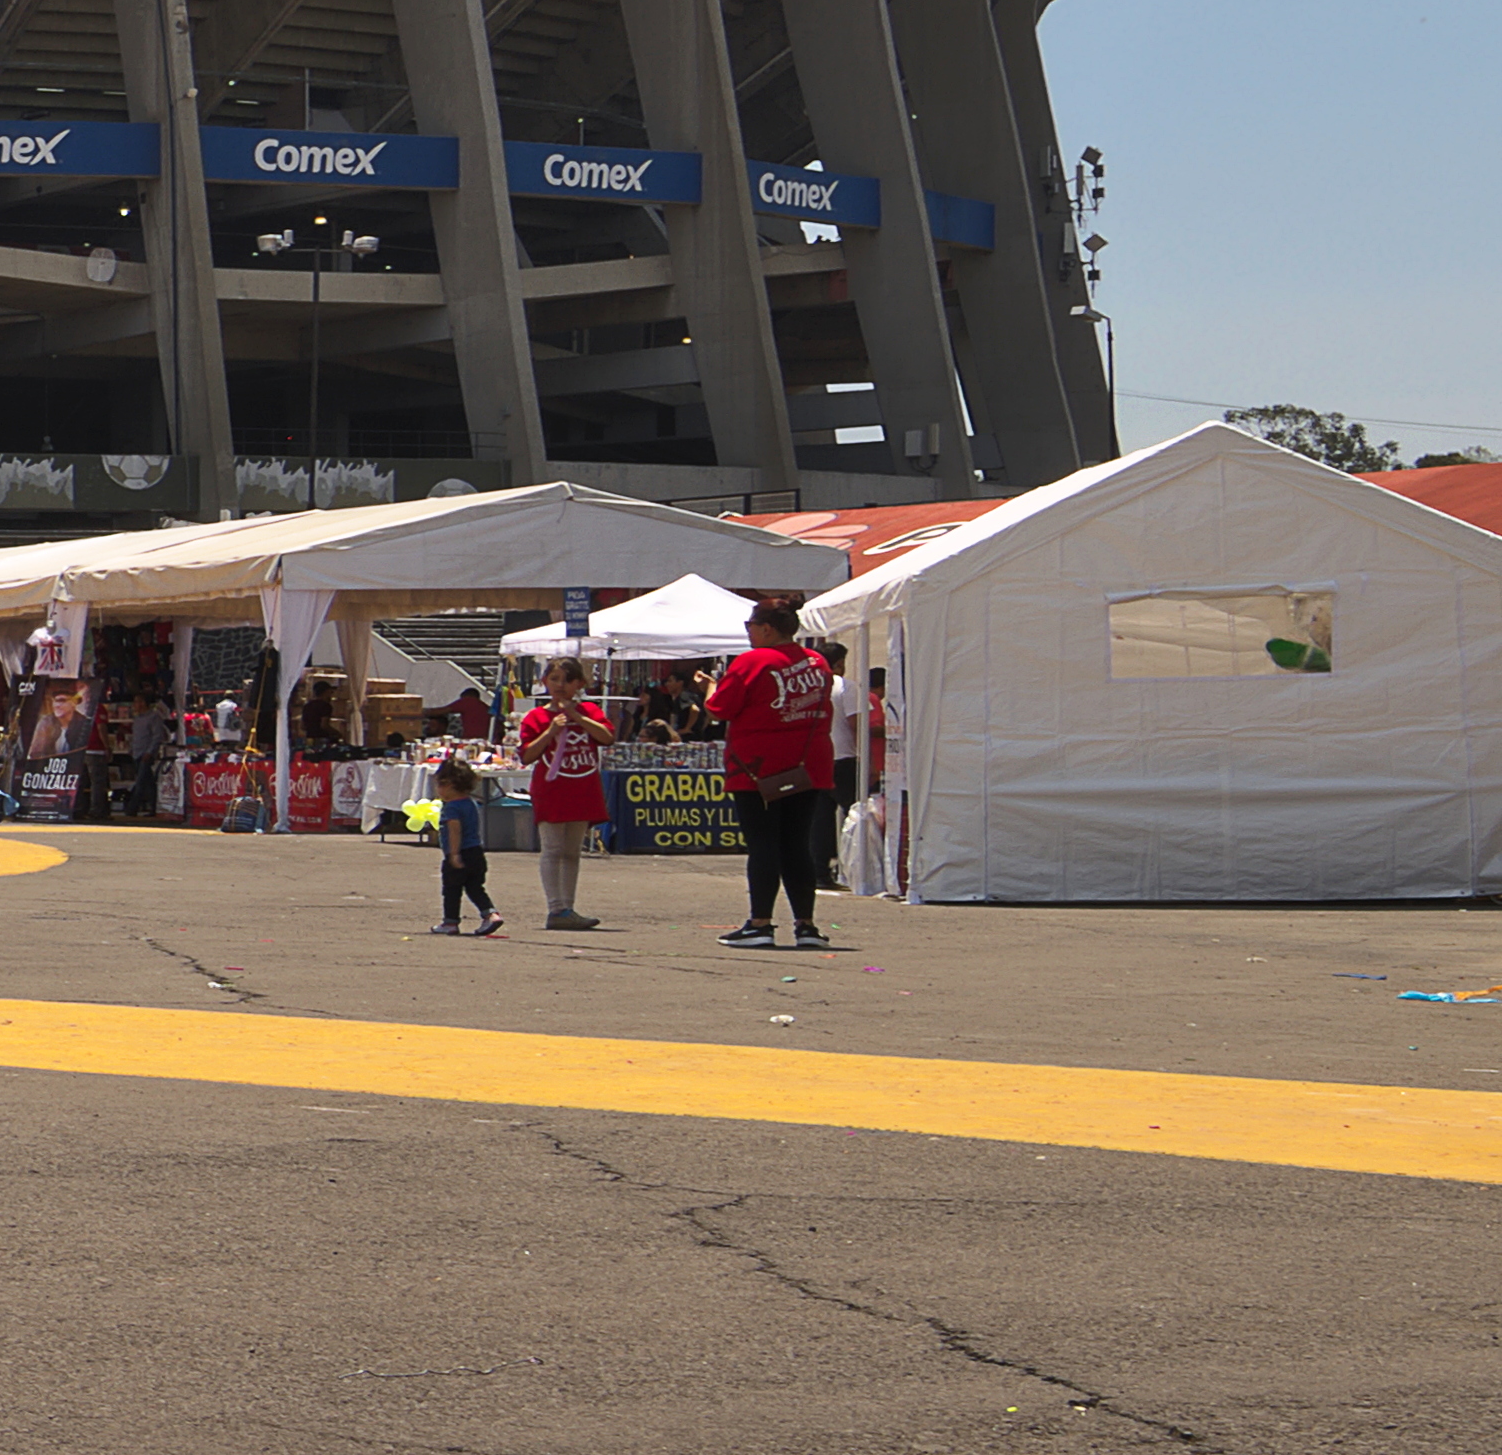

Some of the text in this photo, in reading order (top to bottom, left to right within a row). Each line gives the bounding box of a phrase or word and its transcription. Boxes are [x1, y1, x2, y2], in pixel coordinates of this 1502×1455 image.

[254, 138, 387, 176] Comex
[543, 154, 652, 192] Comex
[759, 171, 838, 211] Comex
[769, 667, 825, 709] Jesús
[44, 757, 68, 774] JOB
[22, 772, 80, 791] GONZALEZ
[625, 774, 735, 803] GRABAD
[635, 808, 701, 826] PLUMAS
[704, 808, 716, 826] Y
[654, 831, 712, 847] CON
